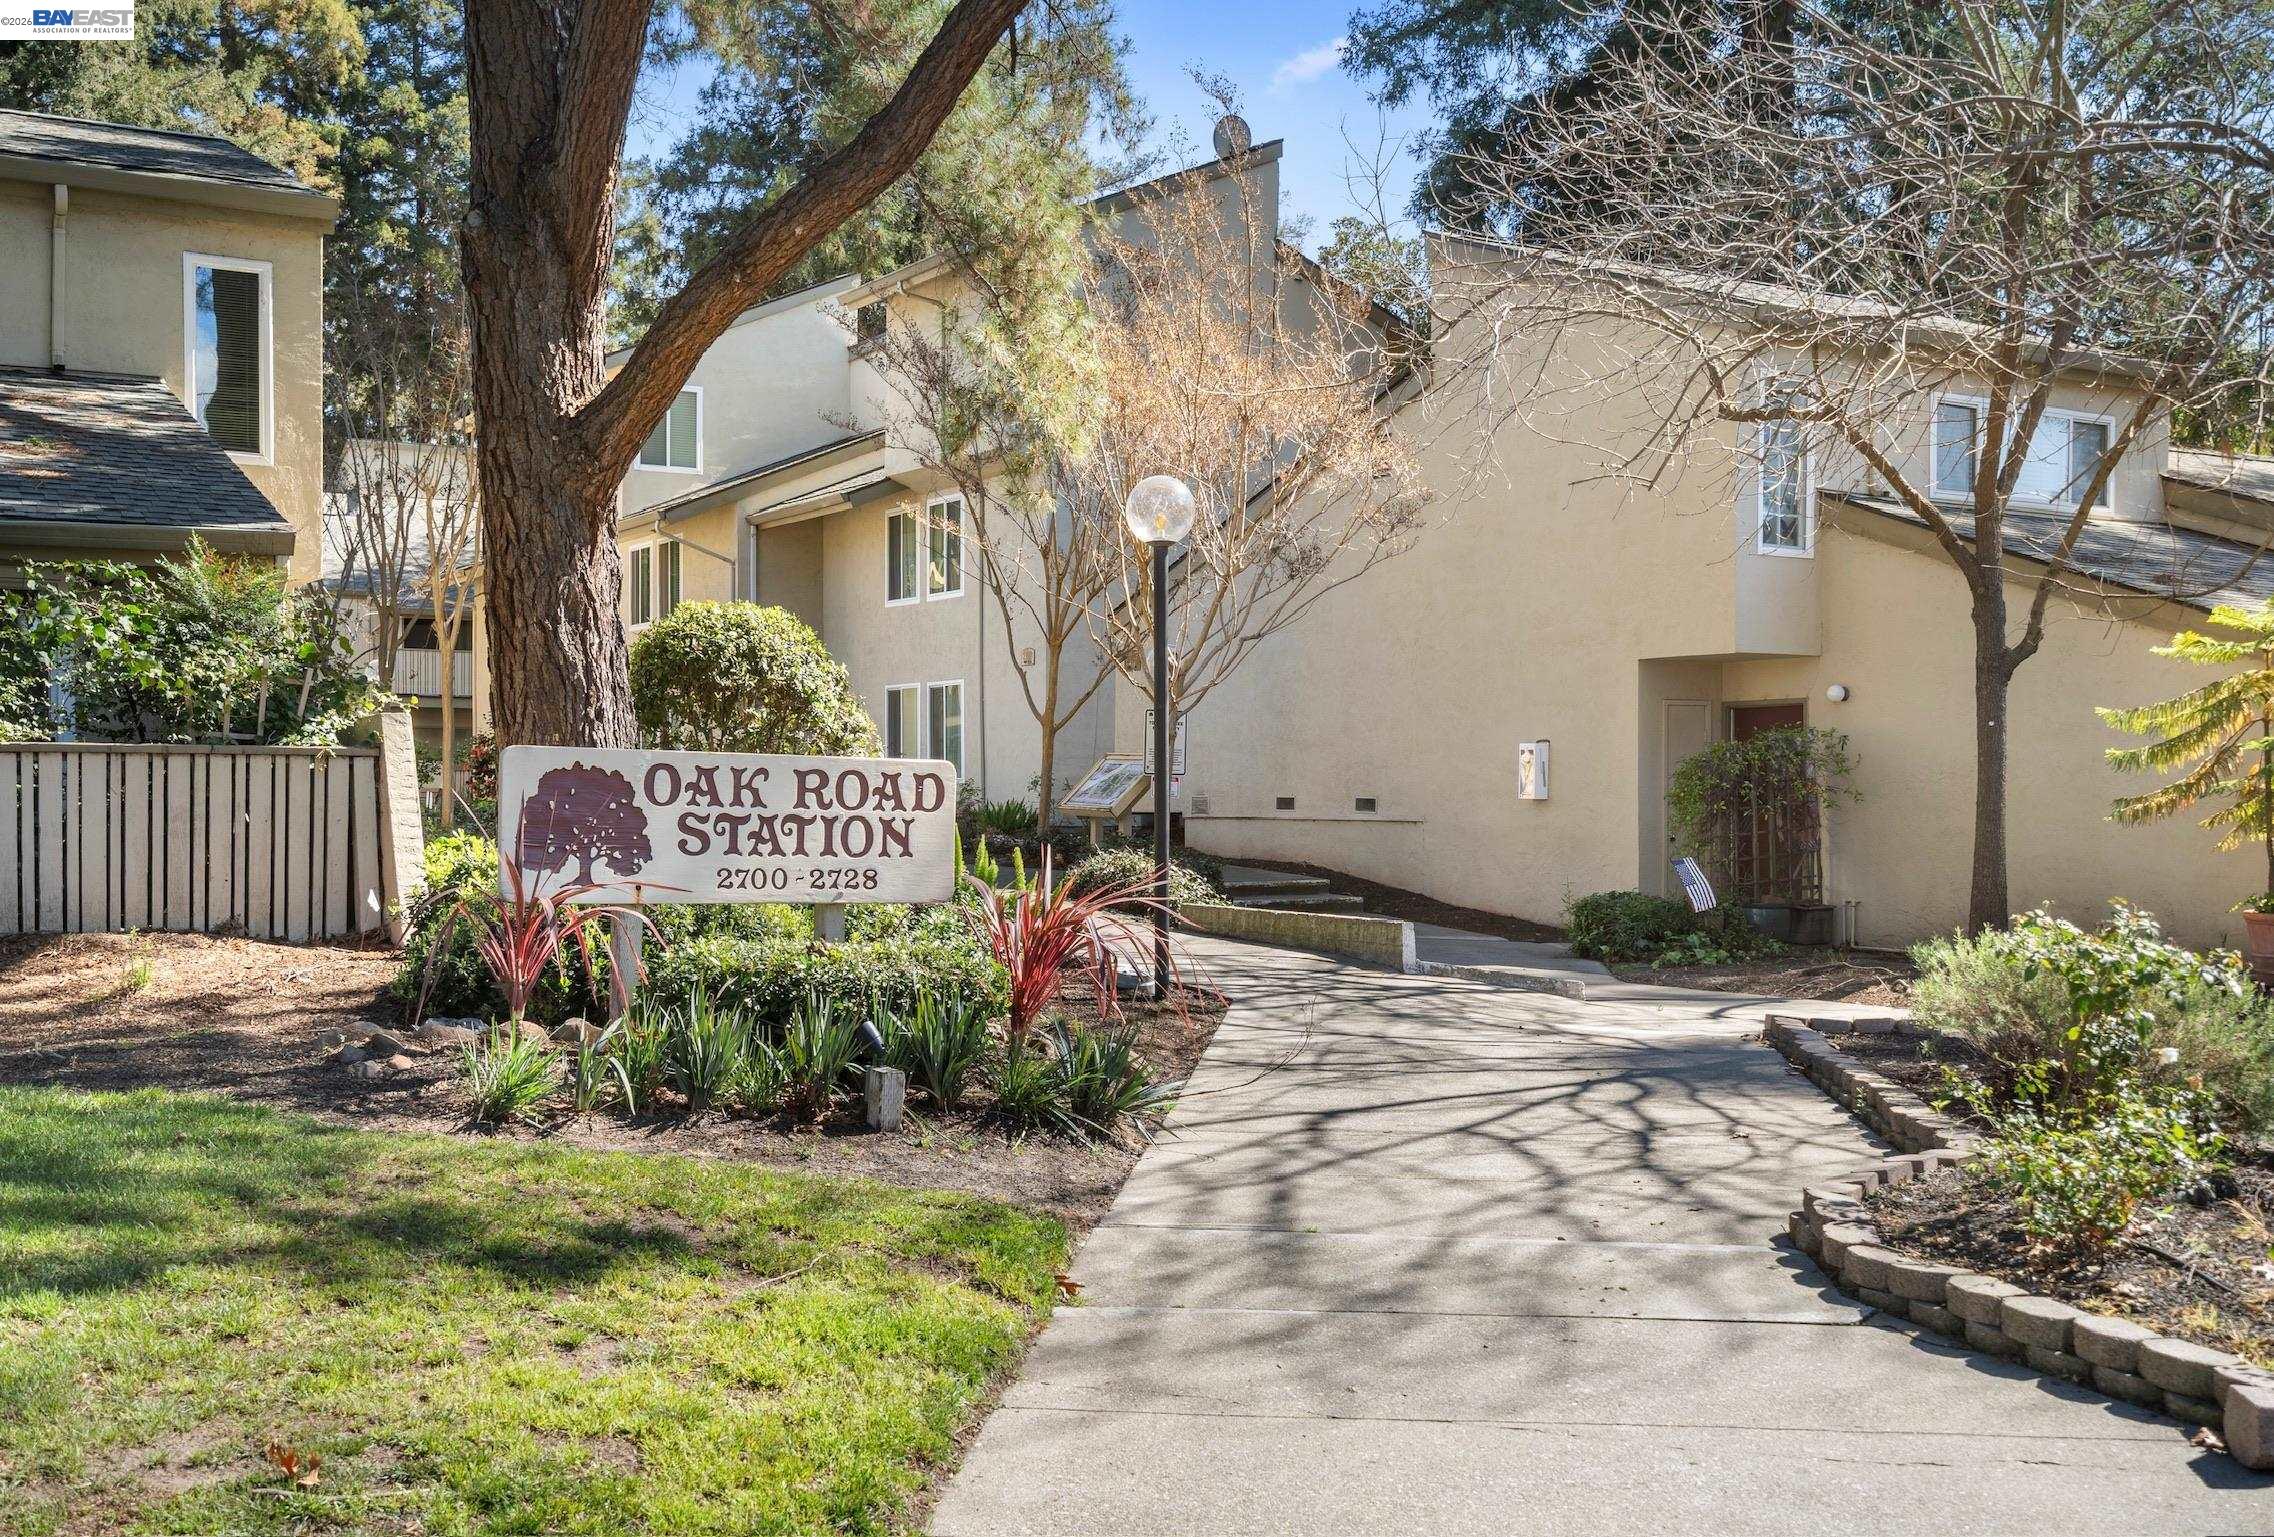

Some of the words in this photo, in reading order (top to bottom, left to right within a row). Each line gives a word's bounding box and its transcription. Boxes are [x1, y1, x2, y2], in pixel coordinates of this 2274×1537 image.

[643, 762, 770, 809] OAK
[793, 768, 945, 813] ROAD
[677, 811, 916, 859] STATION
